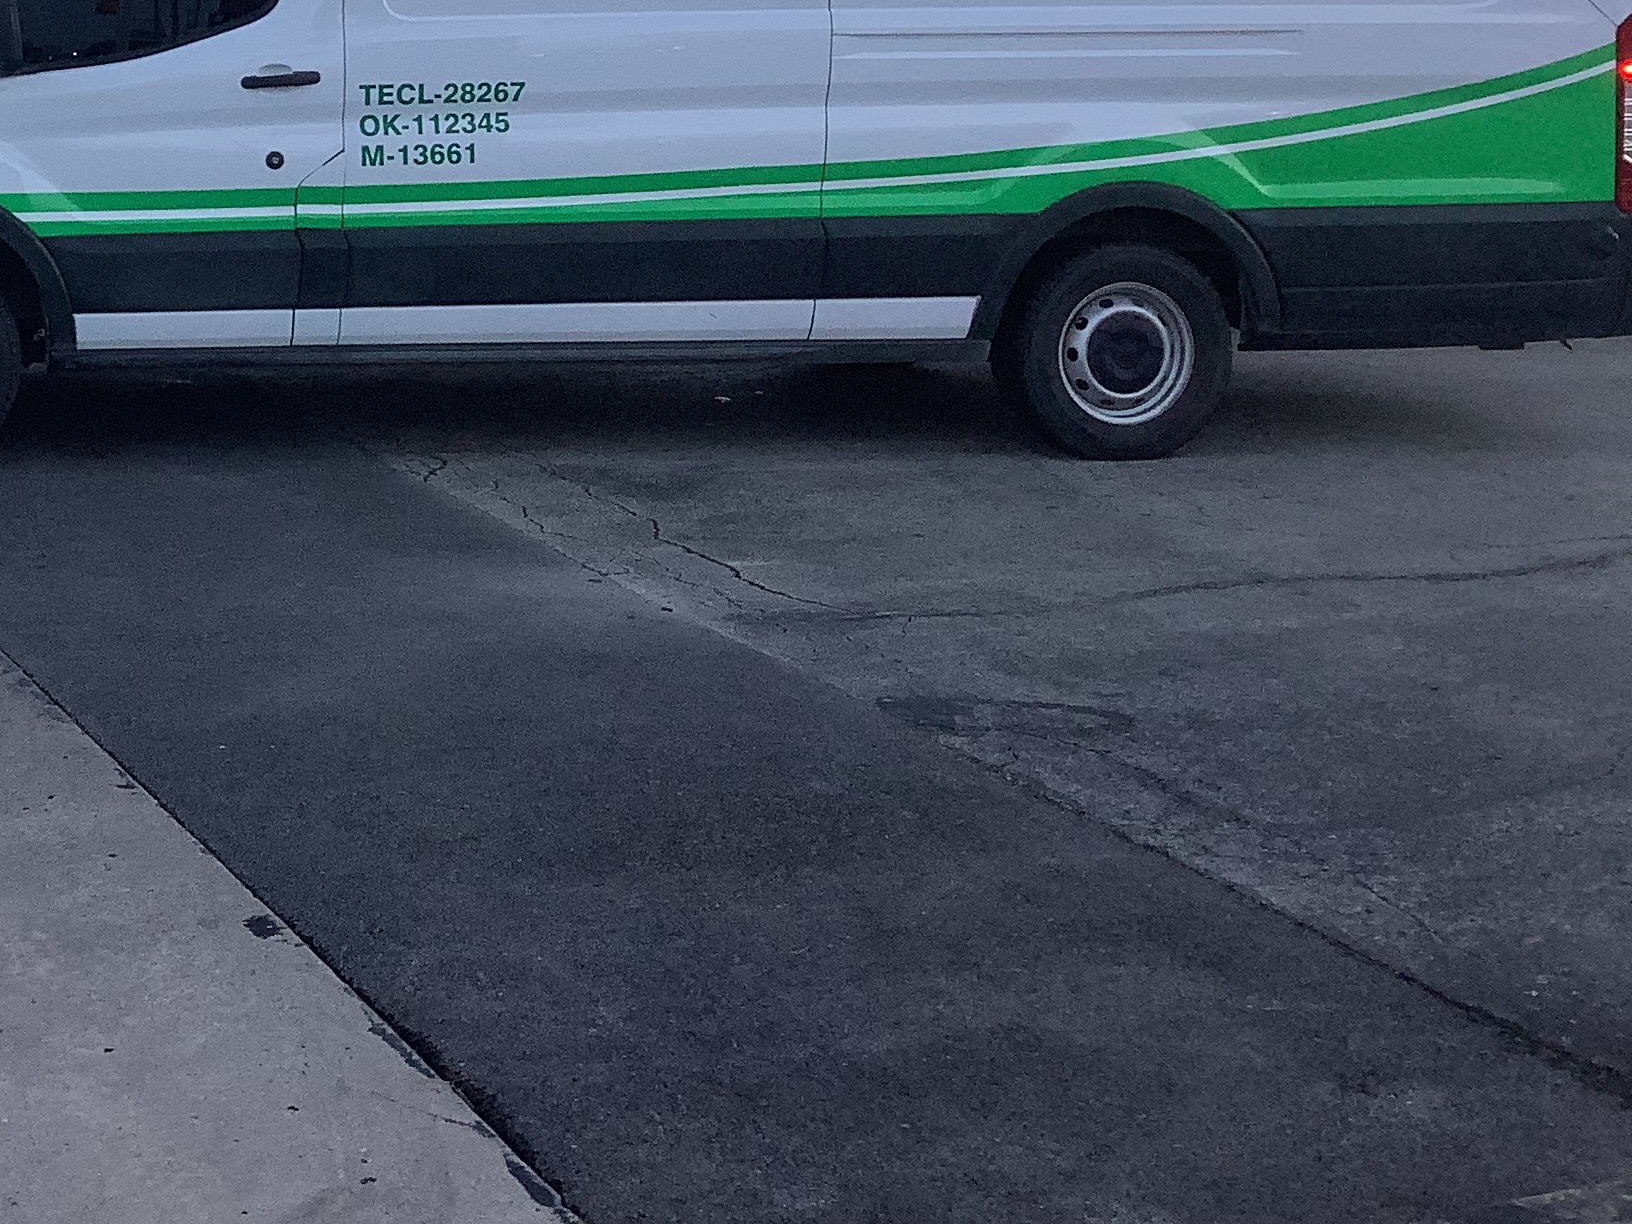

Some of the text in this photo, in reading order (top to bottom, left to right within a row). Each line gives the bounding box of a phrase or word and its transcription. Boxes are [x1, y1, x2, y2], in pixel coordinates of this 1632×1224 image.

[359, 82, 526, 107] TECL-28267
[359, 112, 510, 137] OK-112345
[361, 143, 475, 167] M-13661
